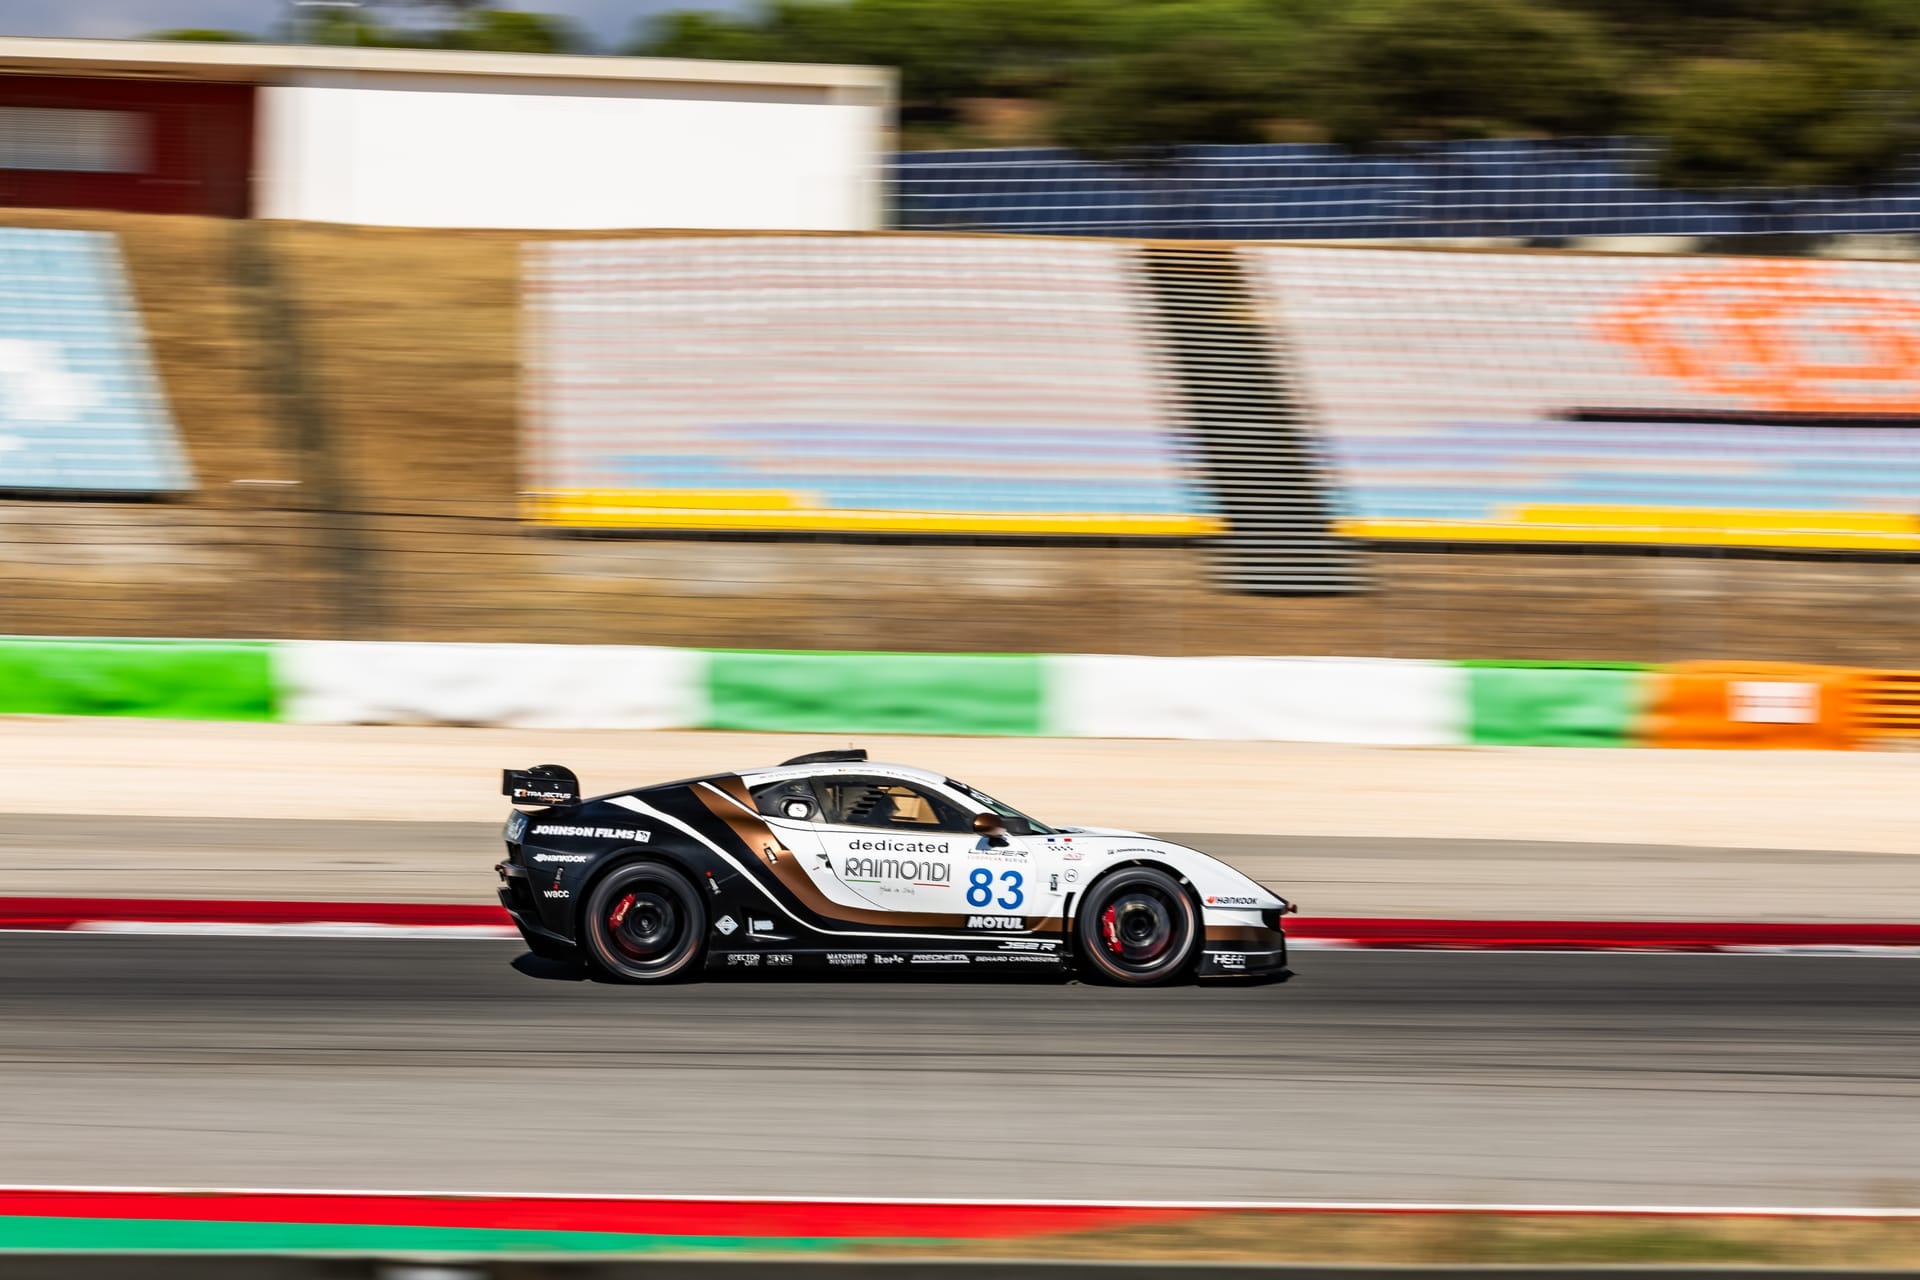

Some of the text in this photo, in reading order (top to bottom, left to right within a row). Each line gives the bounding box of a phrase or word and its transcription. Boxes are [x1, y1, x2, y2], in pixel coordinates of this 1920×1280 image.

[531, 825, 594, 837] JOHNSON
[594, 827, 636, 840] FILMS
[849, 838, 949, 854] dedicated
[845, 857, 950, 882] RAIMONDI
[966, 868, 1024, 910] 83
[967, 916, 1024, 929] MOTUL
